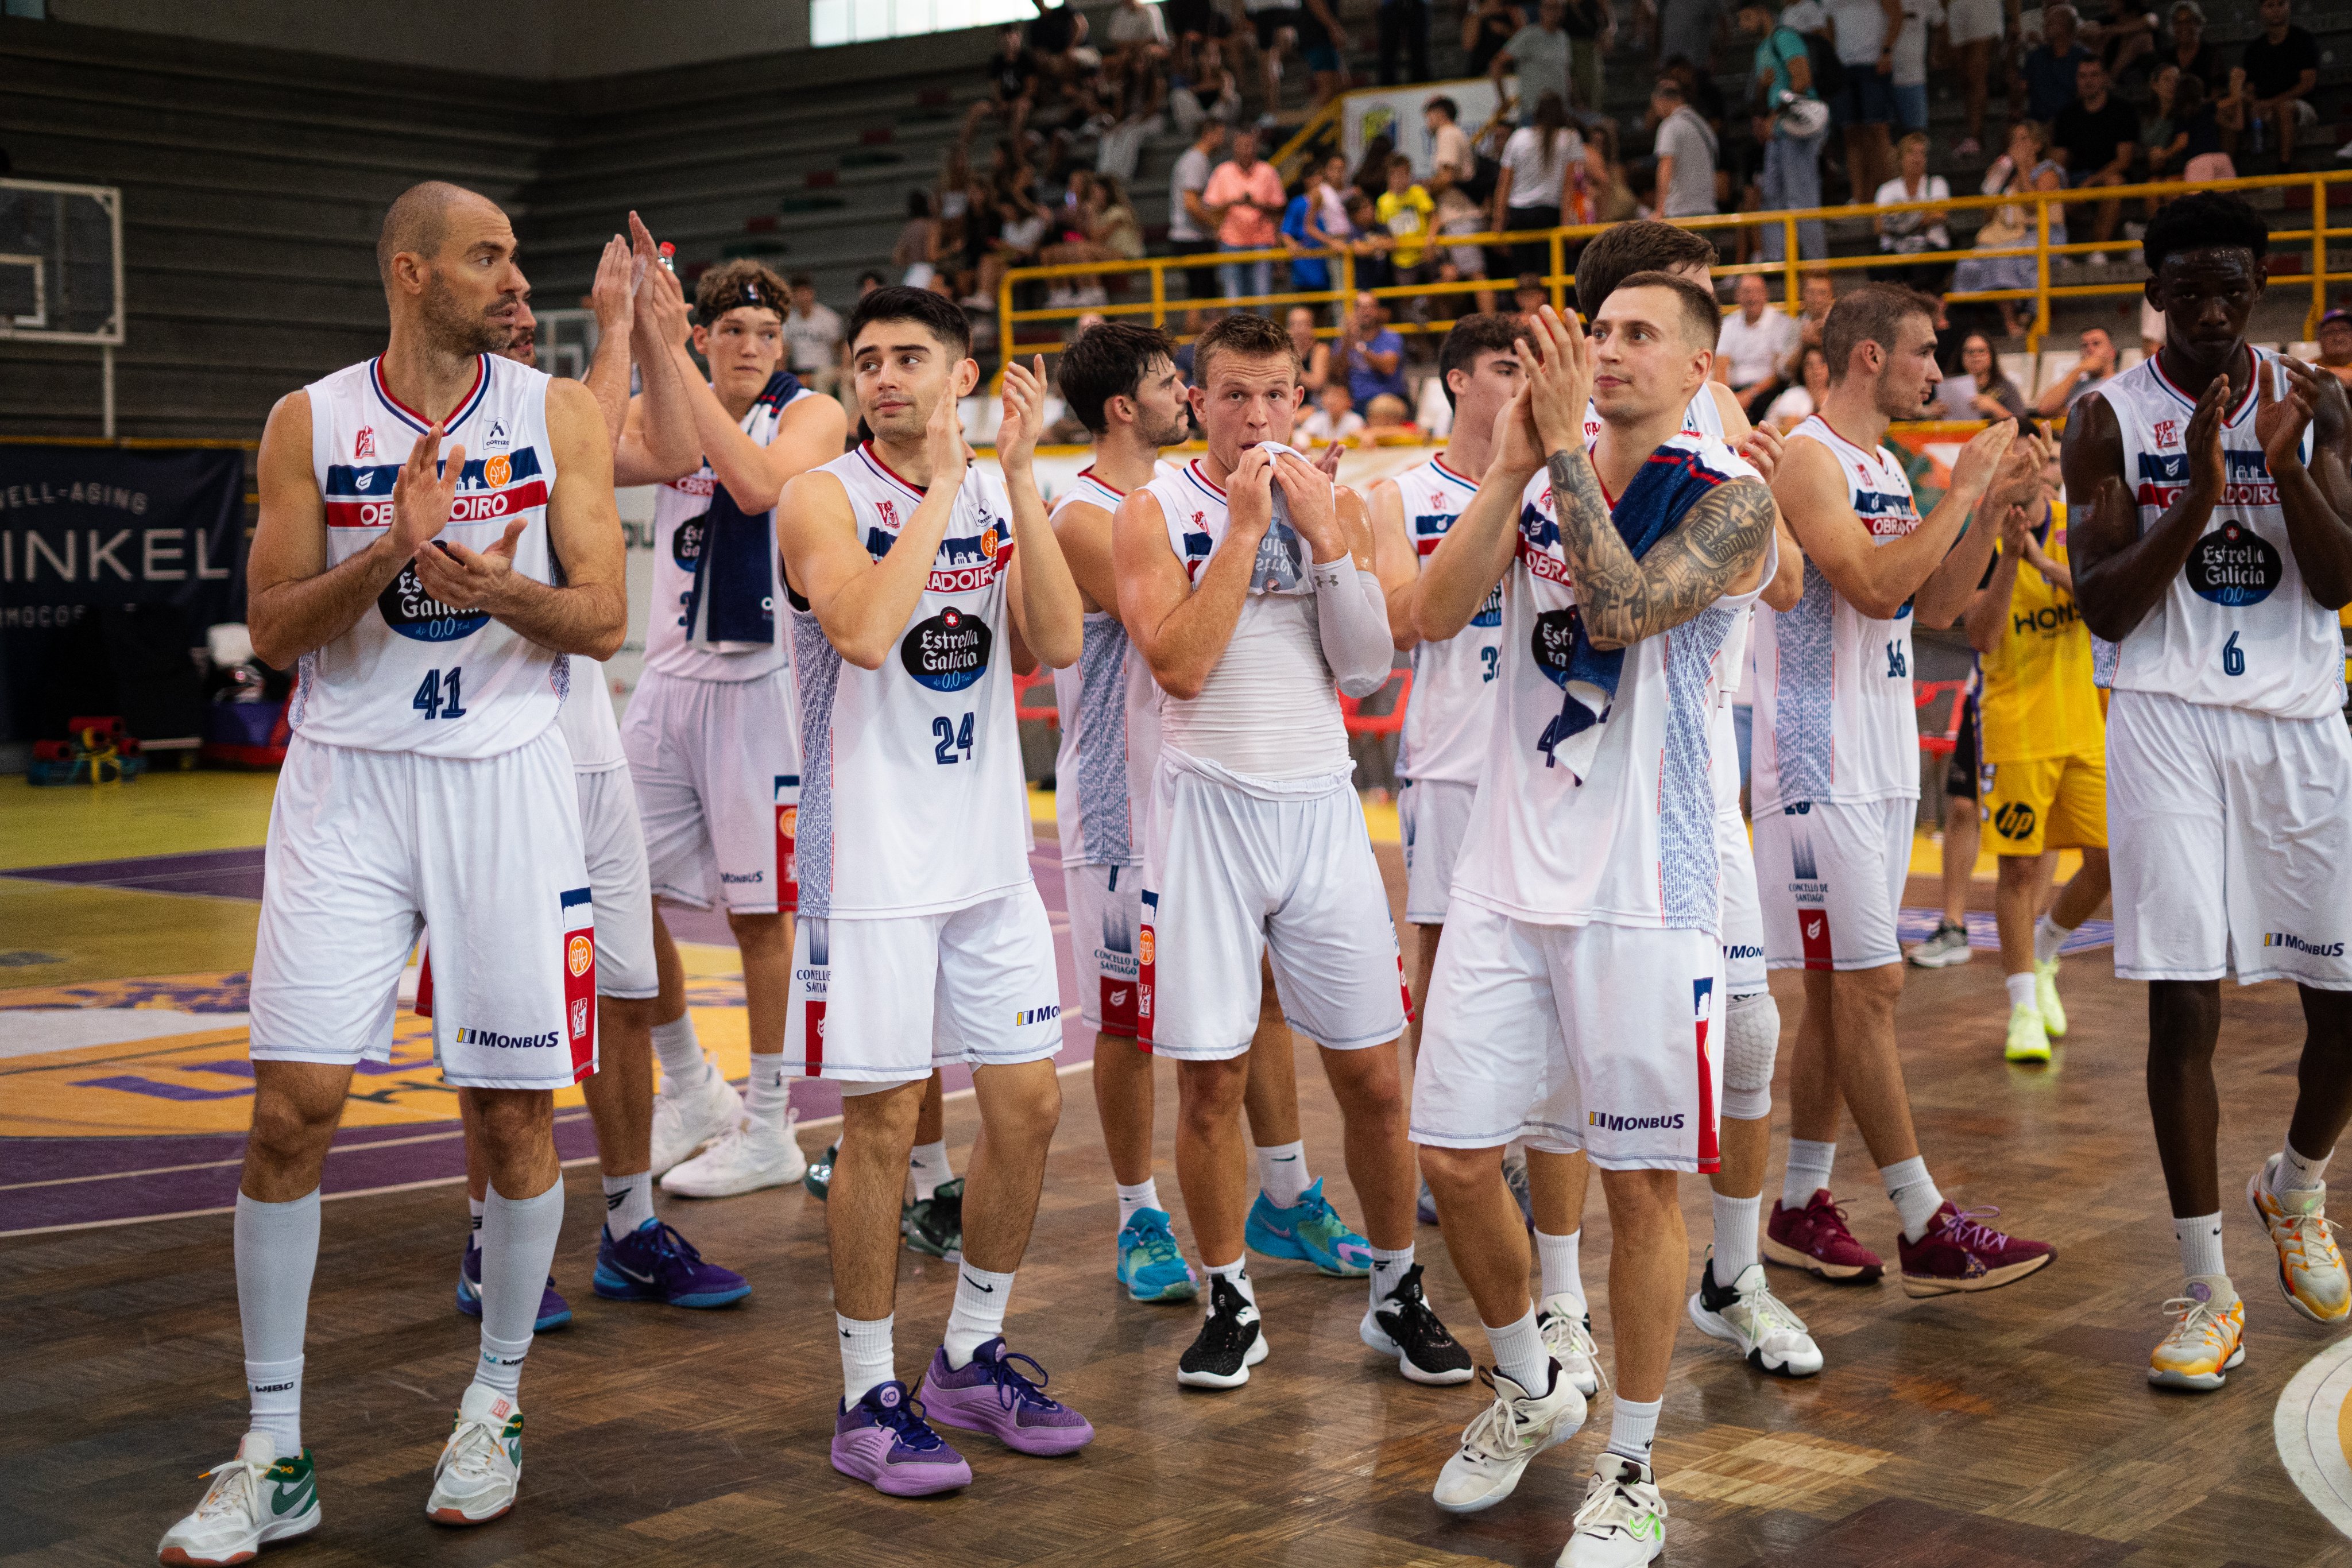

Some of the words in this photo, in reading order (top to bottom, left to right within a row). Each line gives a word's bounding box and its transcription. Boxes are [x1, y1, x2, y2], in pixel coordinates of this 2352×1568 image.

[2202, 545, 2265, 564] Estrella
[920, 629, 979, 649] Estrella
[1886, 639, 1906, 677] 16
[2222, 631, 2245, 676] 6
[923, 649, 978, 670] Galicia
[413, 667, 466, 720] 41
[933, 712, 974, 765] 24
[1999, 802, 2033, 840] hp
